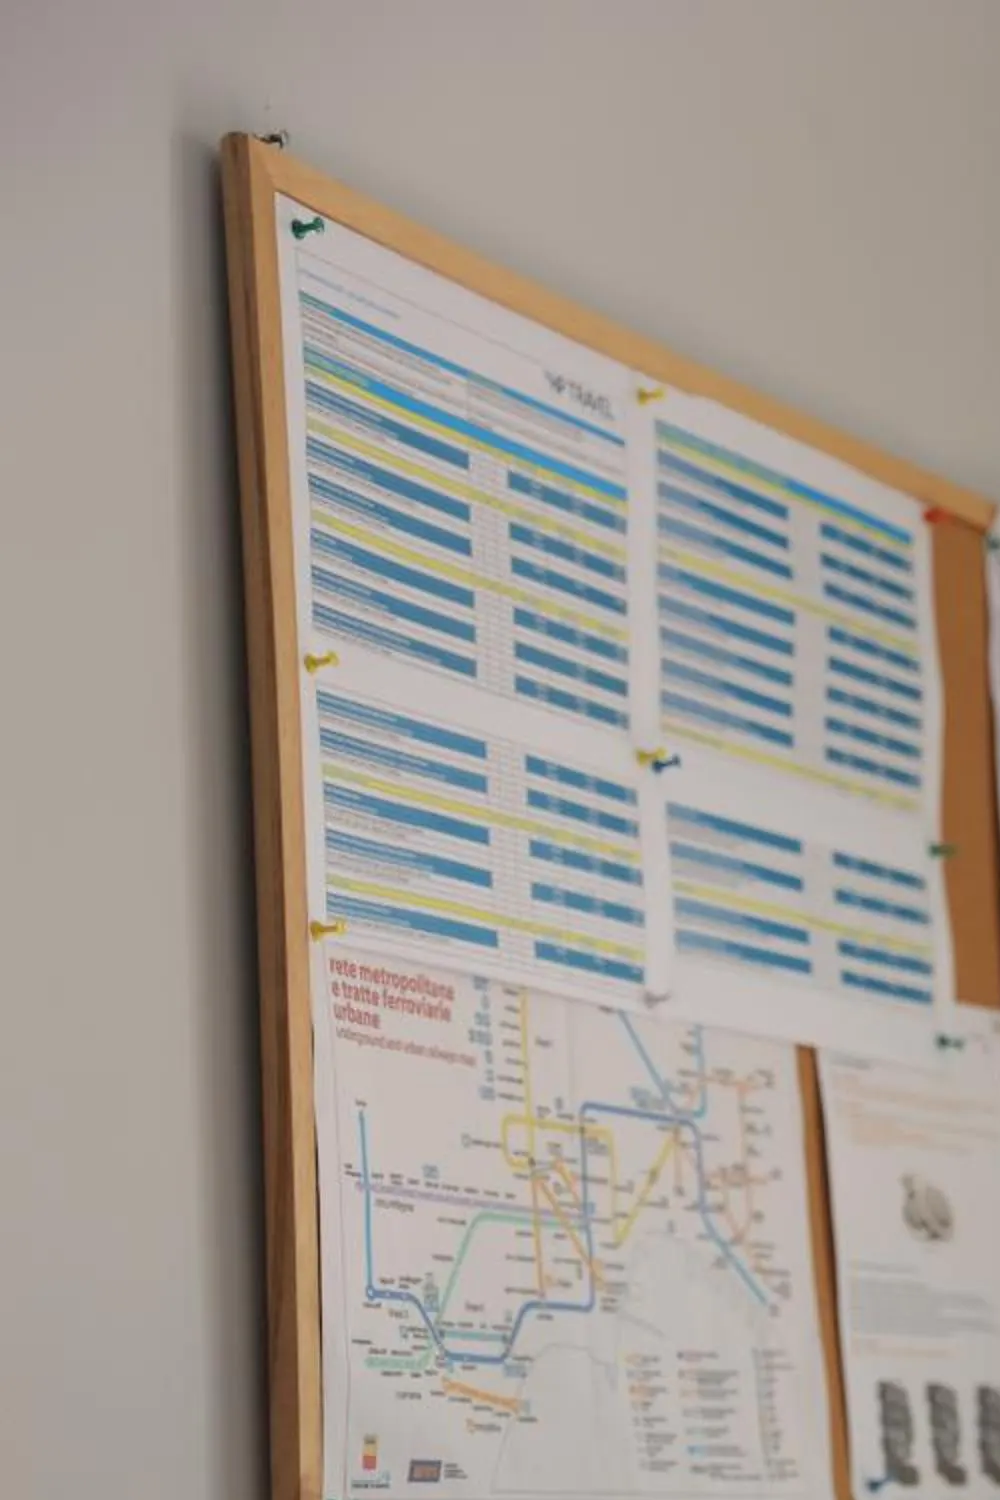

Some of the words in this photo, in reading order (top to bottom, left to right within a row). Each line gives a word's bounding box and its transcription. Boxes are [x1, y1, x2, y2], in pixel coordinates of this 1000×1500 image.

[329, 957, 357, 979] rete
[331, 981, 341, 998] e
[342, 980, 380, 1007] tratte
[383, 988, 453, 1023] ferroviarie
[333, 1001, 381, 1030] urbane
